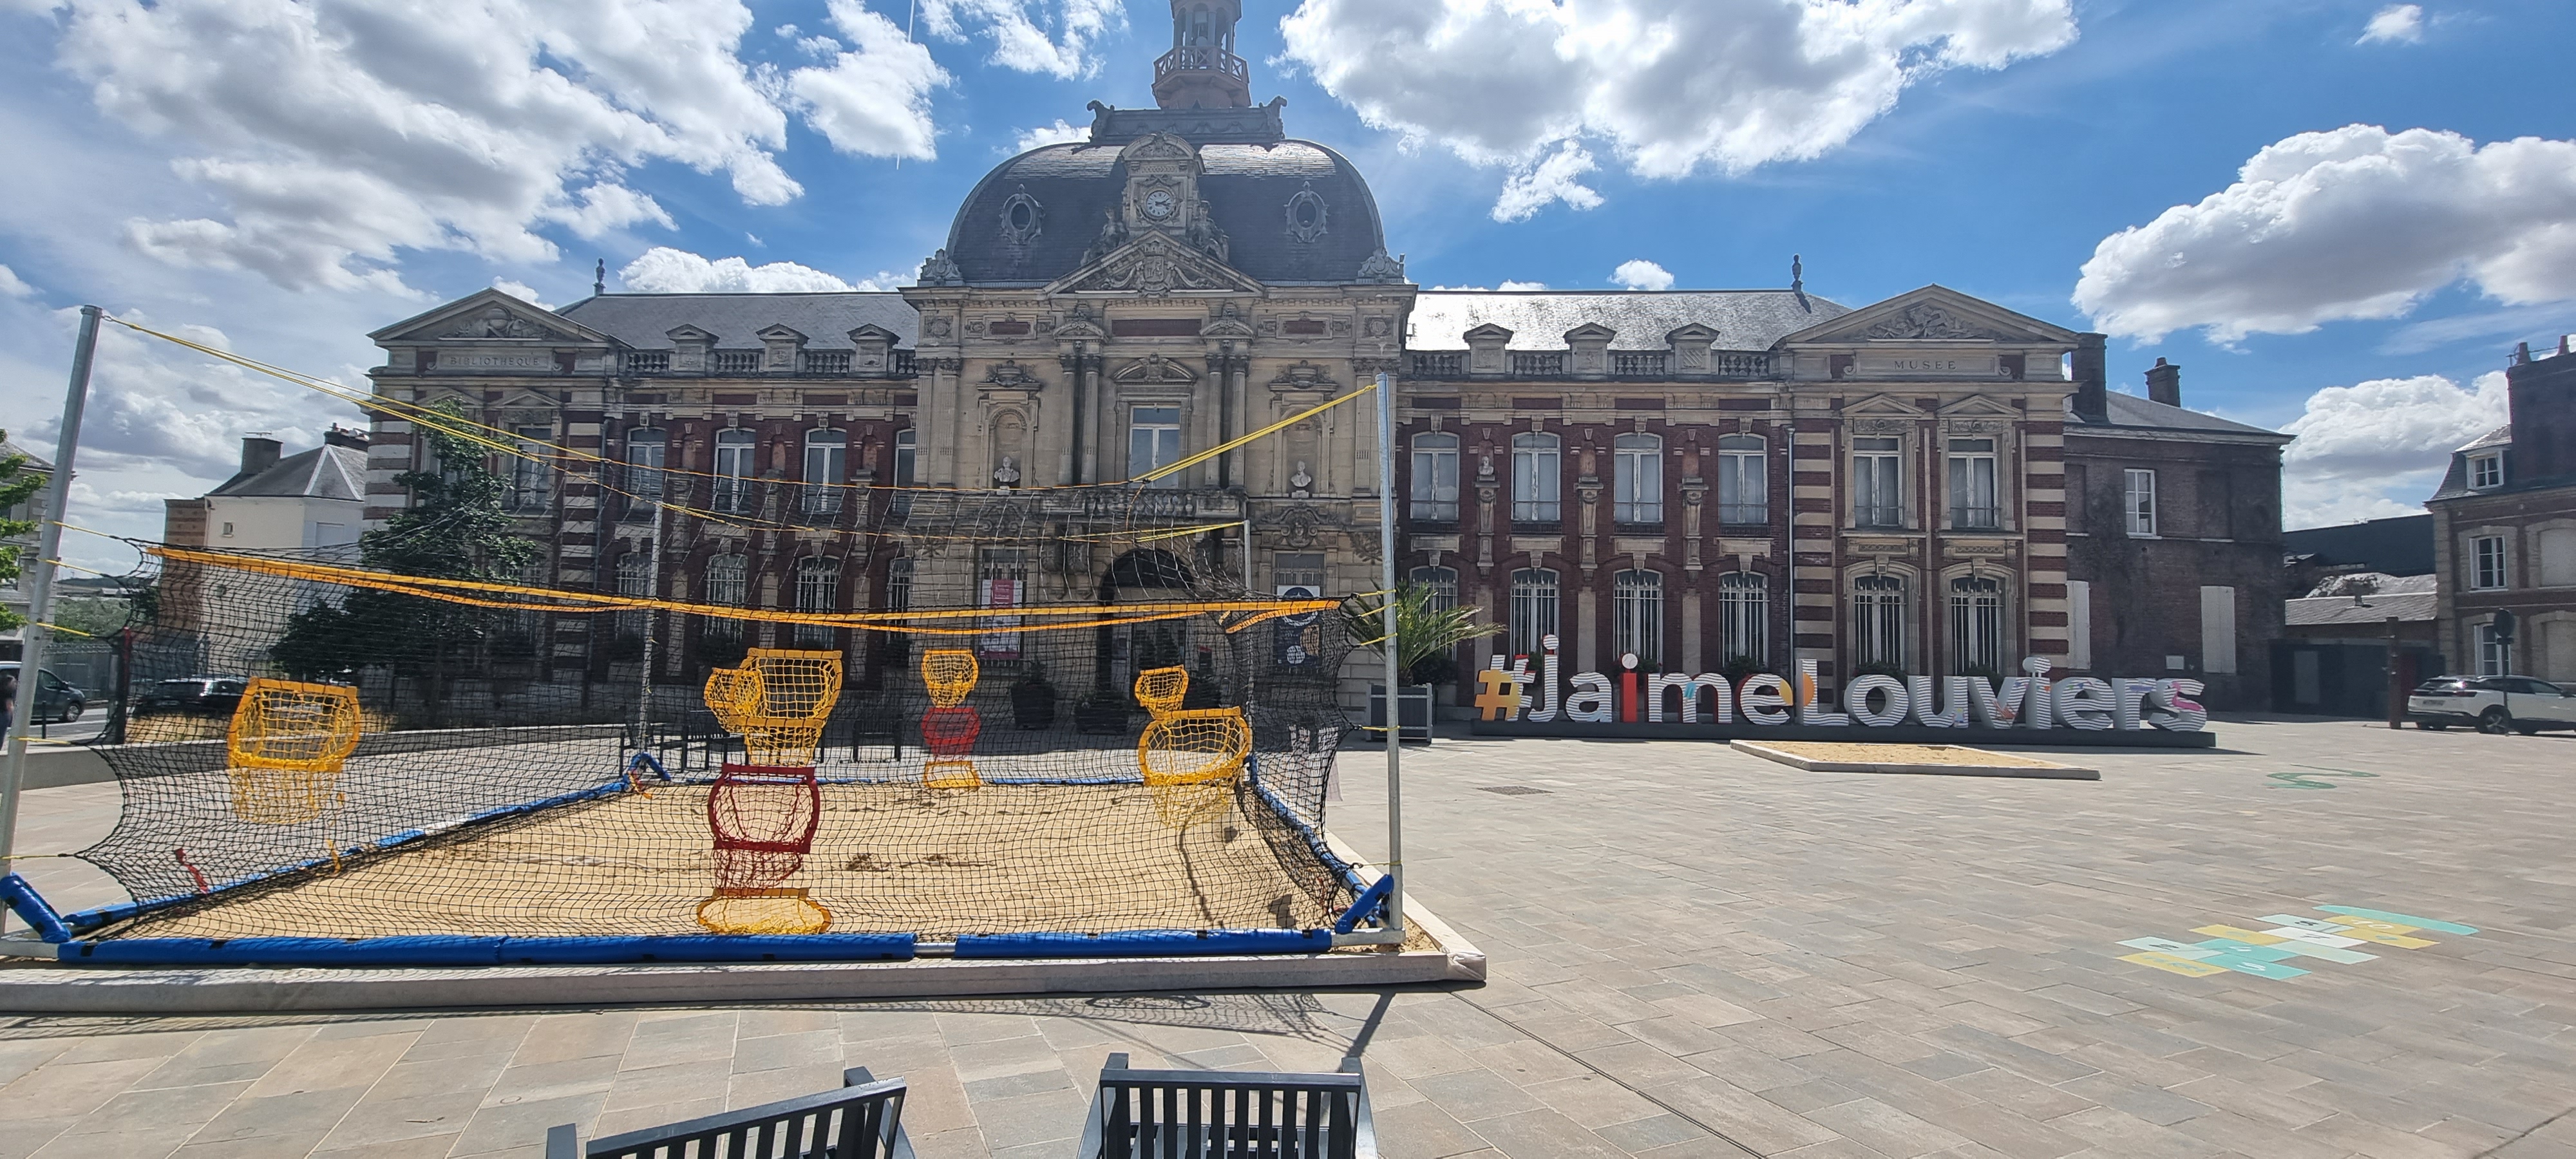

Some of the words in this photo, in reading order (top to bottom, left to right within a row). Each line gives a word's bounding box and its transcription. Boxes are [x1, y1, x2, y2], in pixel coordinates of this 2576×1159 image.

[450, 357, 539, 367] BIBLIOTHEQUE
[1895, 361, 1956, 370] MUSEE
[2351, 919, 2394, 929] 10
